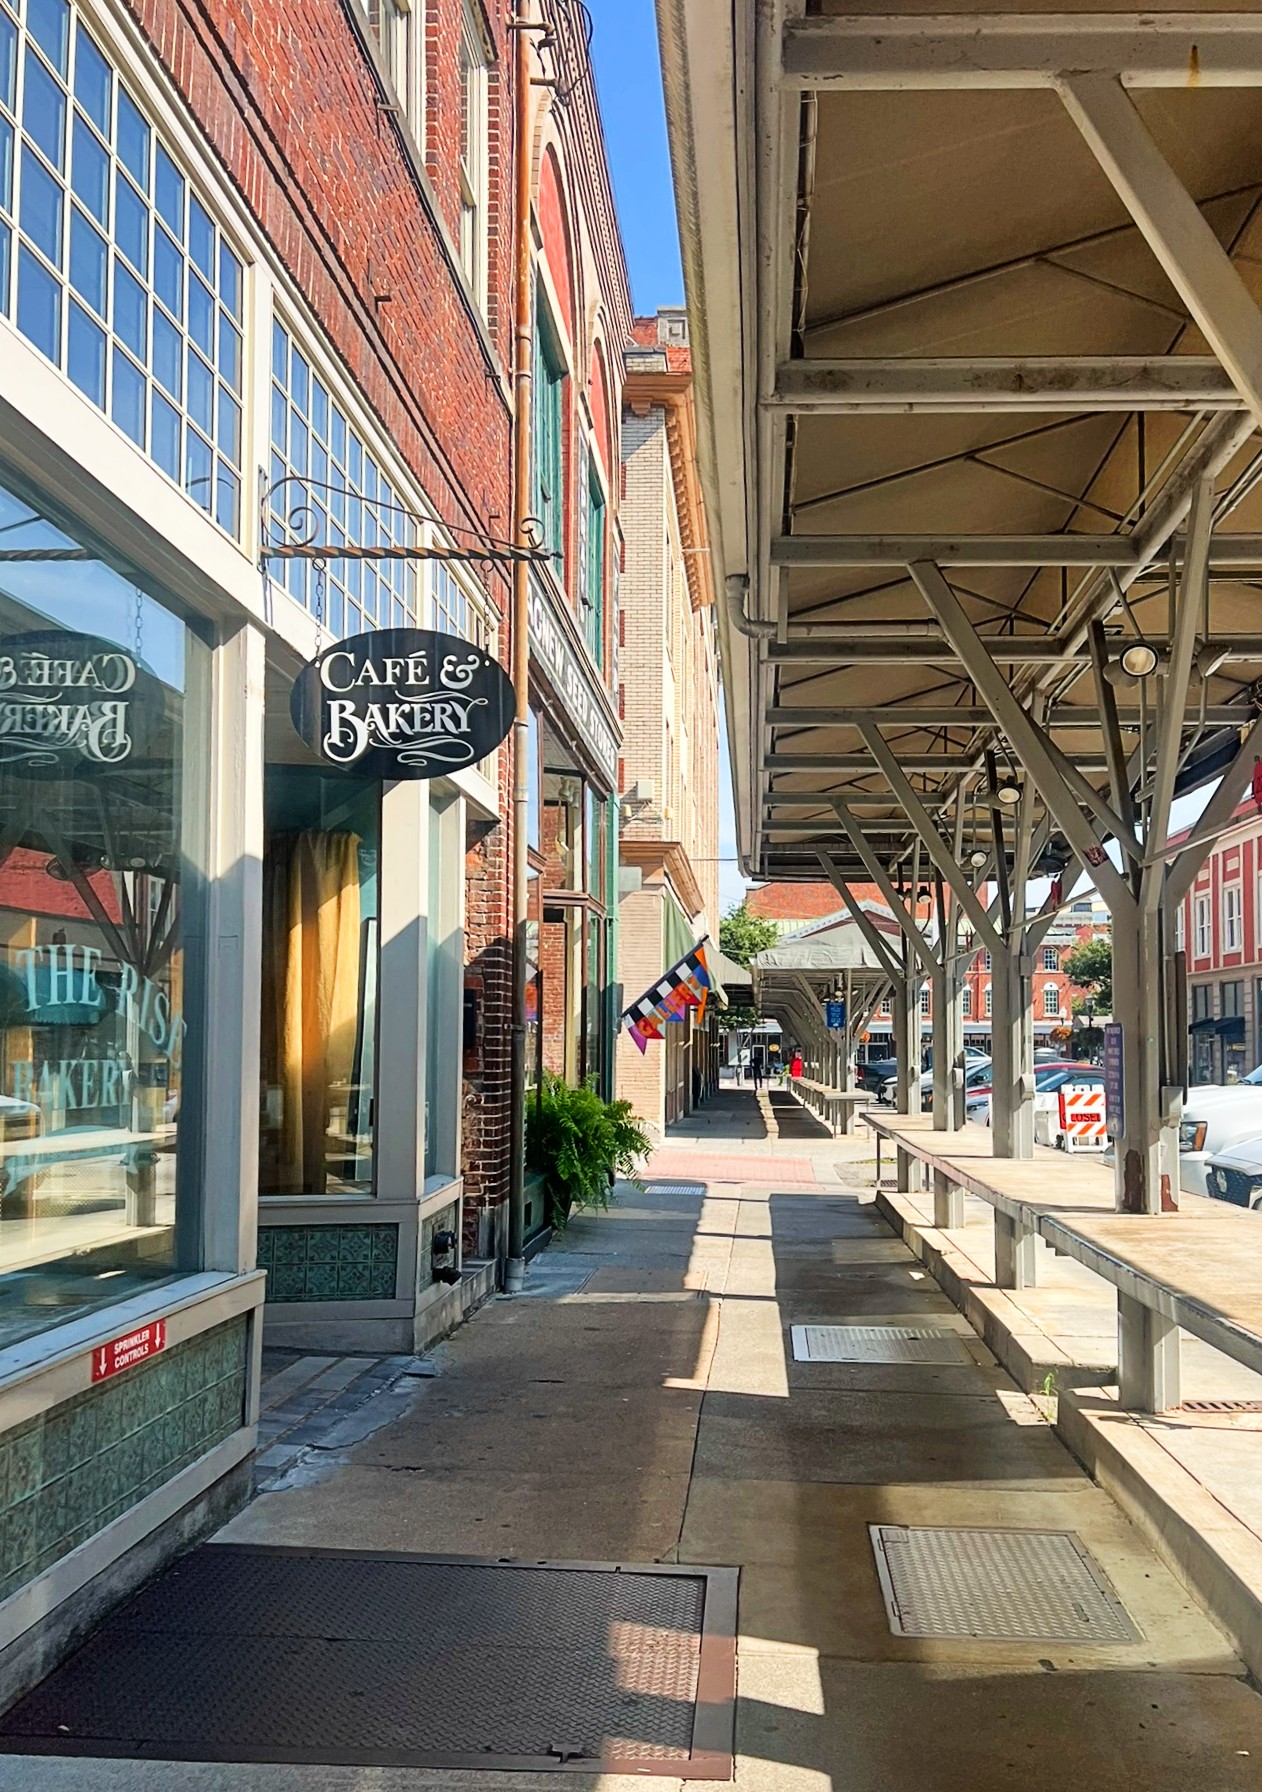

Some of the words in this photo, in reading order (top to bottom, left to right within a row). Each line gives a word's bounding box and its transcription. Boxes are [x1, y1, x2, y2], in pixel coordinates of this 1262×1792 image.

[320, 650, 430, 692] CAFÉ
[439, 654, 480, 689] &
[566, 664, 588, 724] SEED
[323, 699, 472, 763] BAKERY
[16, 944, 102, 1013] THE
[637, 974, 700, 1037] GALLERY
[114, 1329, 150, 1355] SPRINKLER
[114, 1343, 149, 1369] CONTROLS
